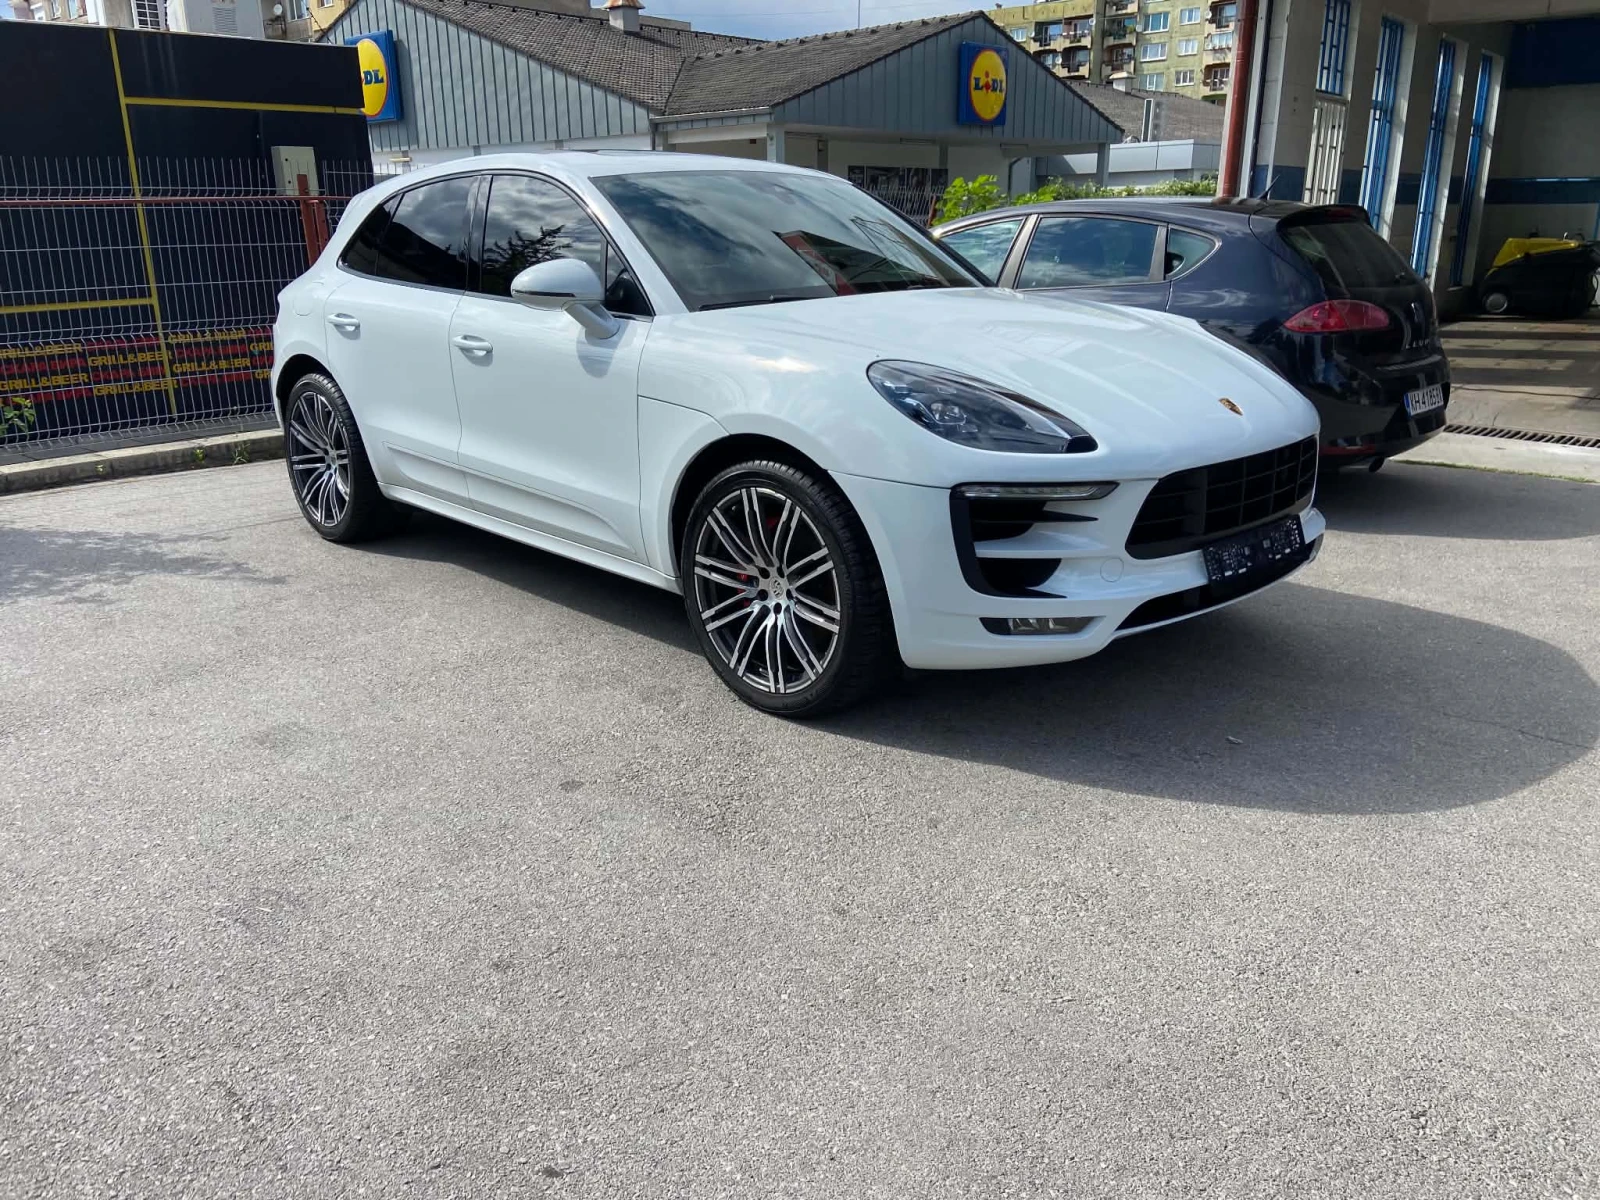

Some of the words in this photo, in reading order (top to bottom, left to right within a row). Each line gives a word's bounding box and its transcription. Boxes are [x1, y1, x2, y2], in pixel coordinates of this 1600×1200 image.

[361, 69, 384, 85] DL
[0, 343, 82, 358] RILL&BEER
[172, 357, 251, 373] GRILL&BEER
[0, 373, 89, 391] GRILL&BEER
